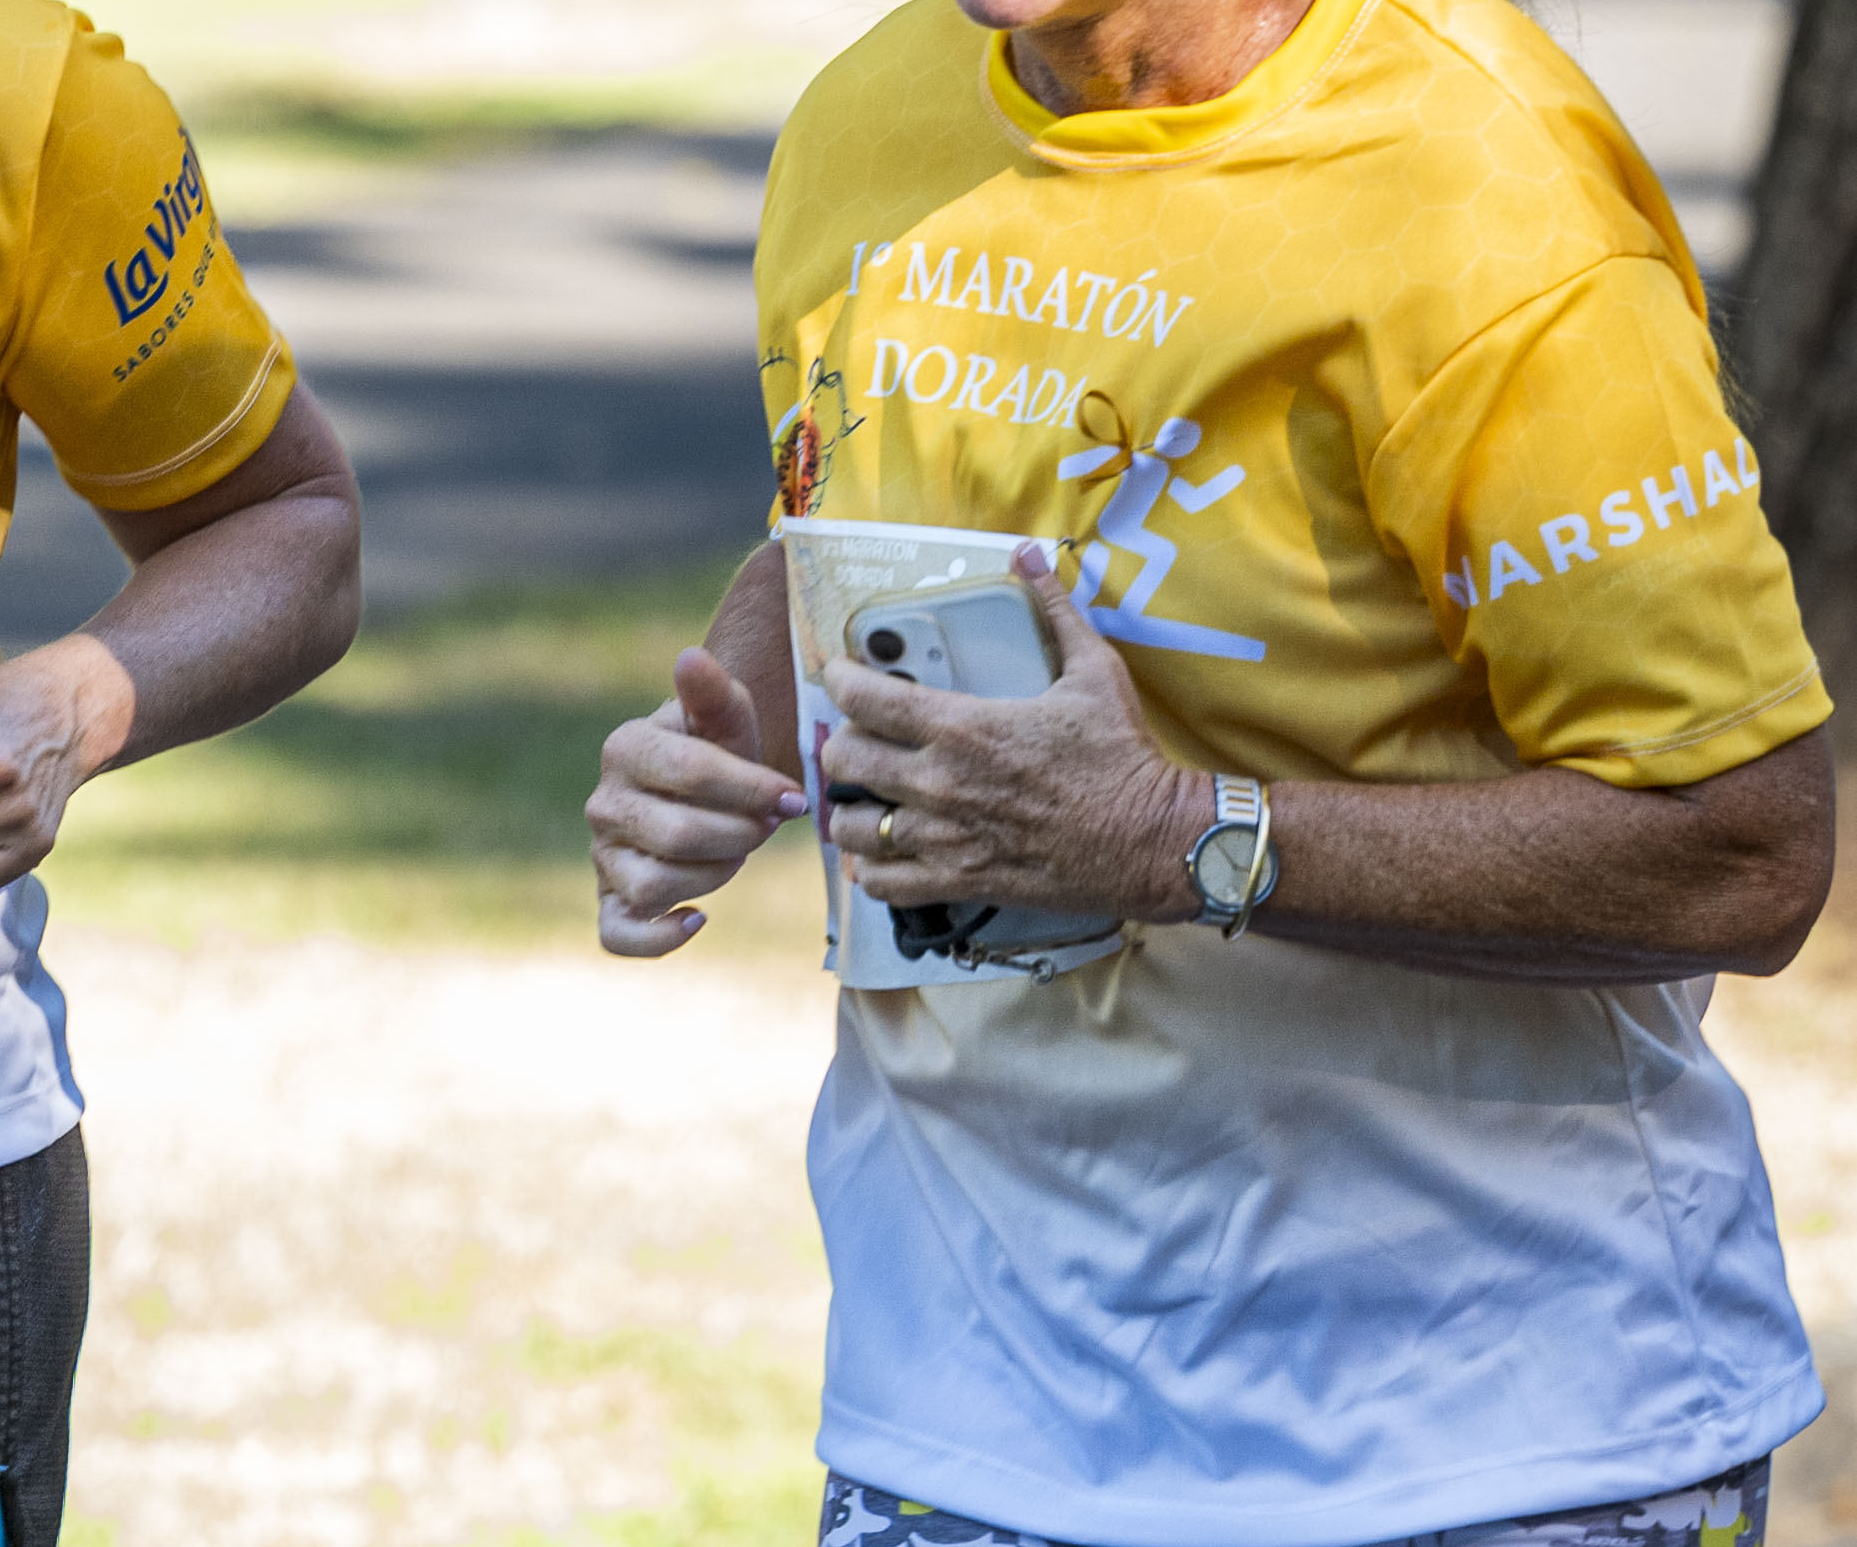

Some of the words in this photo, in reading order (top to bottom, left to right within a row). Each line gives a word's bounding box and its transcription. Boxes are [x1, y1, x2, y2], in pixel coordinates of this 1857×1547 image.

[103, 247, 170, 328] La
[897, 240, 1196, 349] MARATÓN
[112, 289, 195, 383] SABORES
[863, 337, 1089, 429] DORADA
